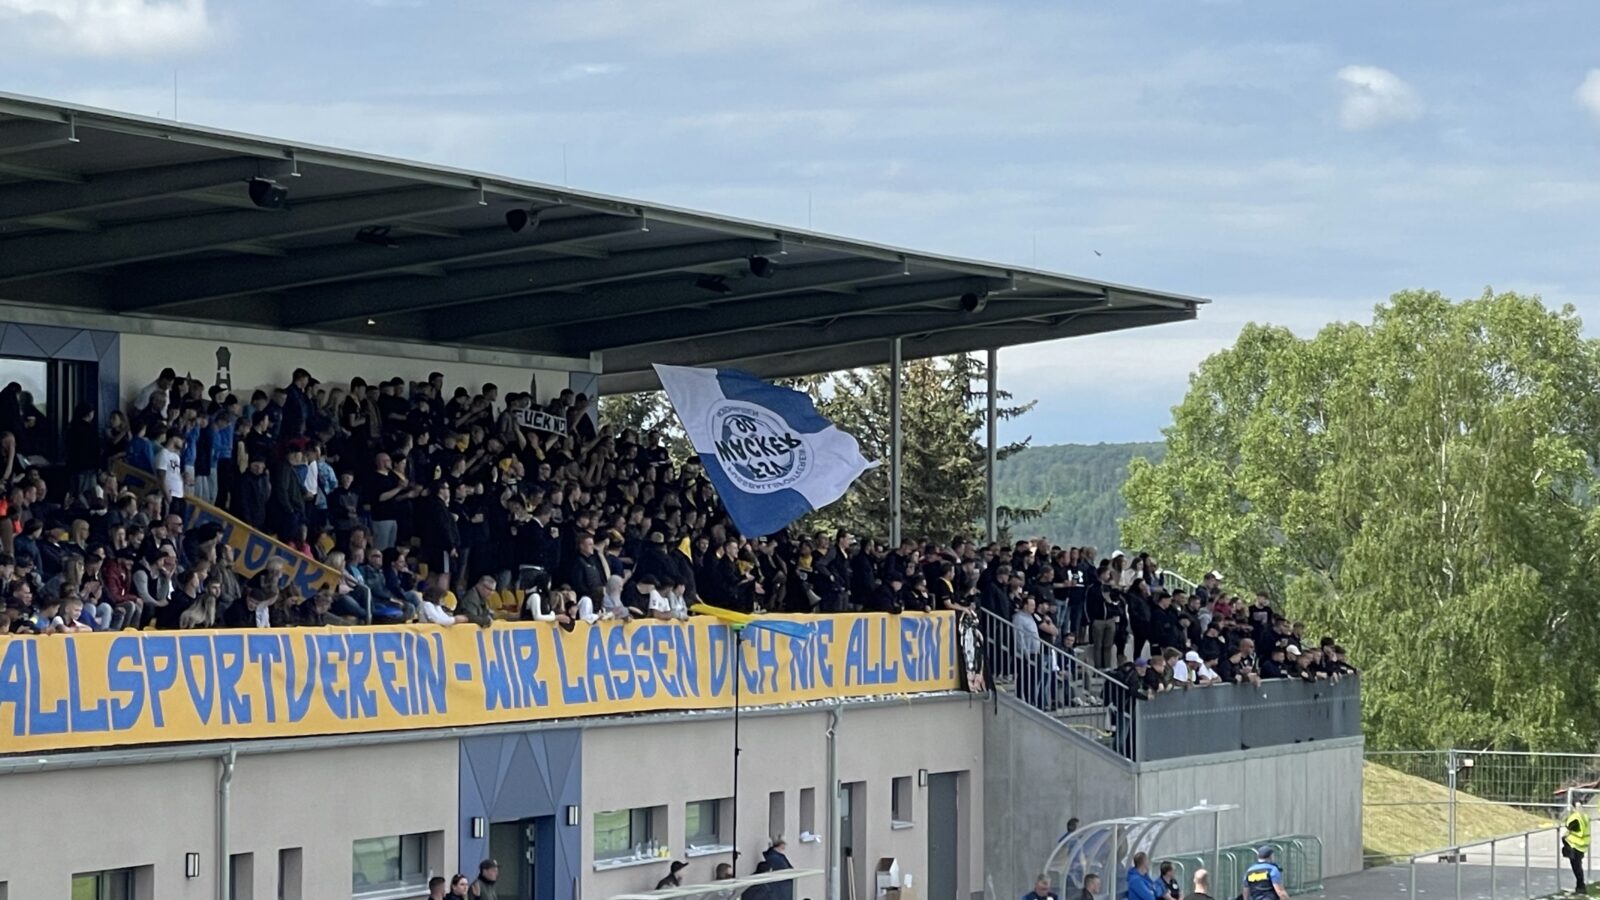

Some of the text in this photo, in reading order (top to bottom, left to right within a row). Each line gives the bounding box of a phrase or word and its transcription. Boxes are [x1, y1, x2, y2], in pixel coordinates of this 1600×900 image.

[477, 628, 548, 711] WIR
[553, 624, 701, 705] LASSEN
[708, 624, 778, 697] DICH
[789, 619, 833, 691] NIE
